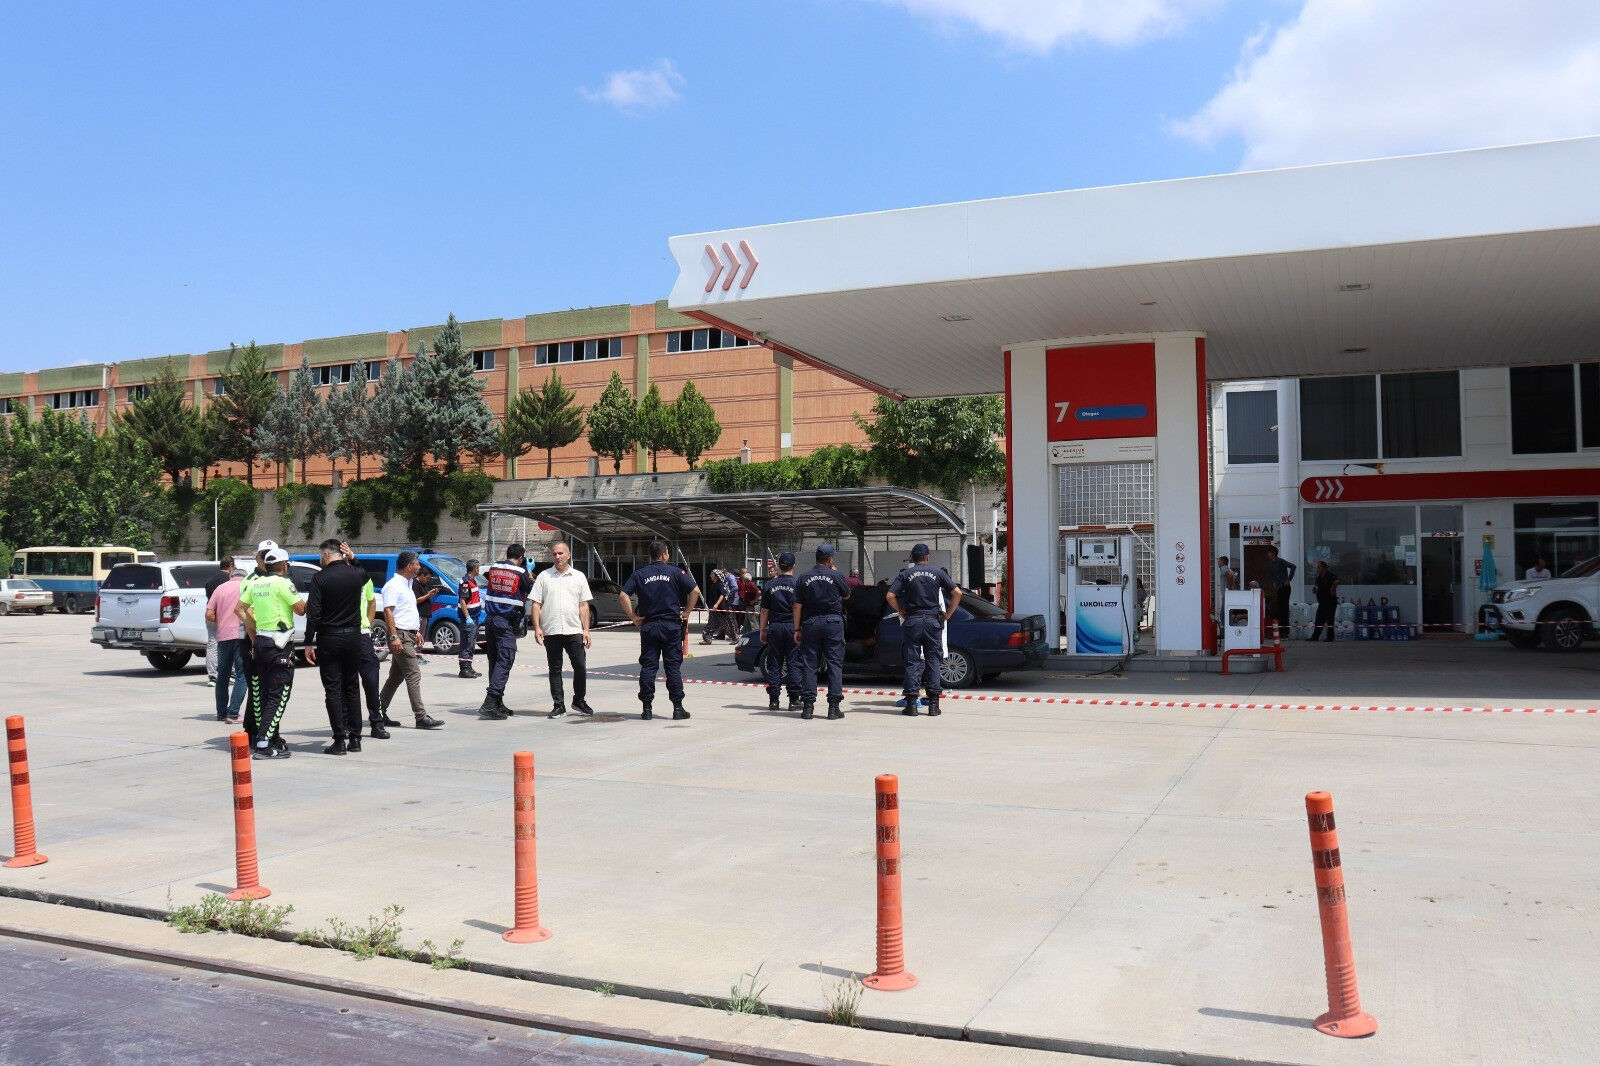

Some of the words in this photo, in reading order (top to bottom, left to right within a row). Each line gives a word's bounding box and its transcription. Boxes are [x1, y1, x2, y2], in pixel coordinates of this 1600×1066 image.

[1054, 401, 1070, 423] 7
[1281, 515, 1292, 523] WC
[644, 574, 671, 585] JANDARMA
[804, 575, 834, 587] JANDARMA
[908, 571, 937, 582] JANDARMA
[771, 585, 794, 595] JANDARM
